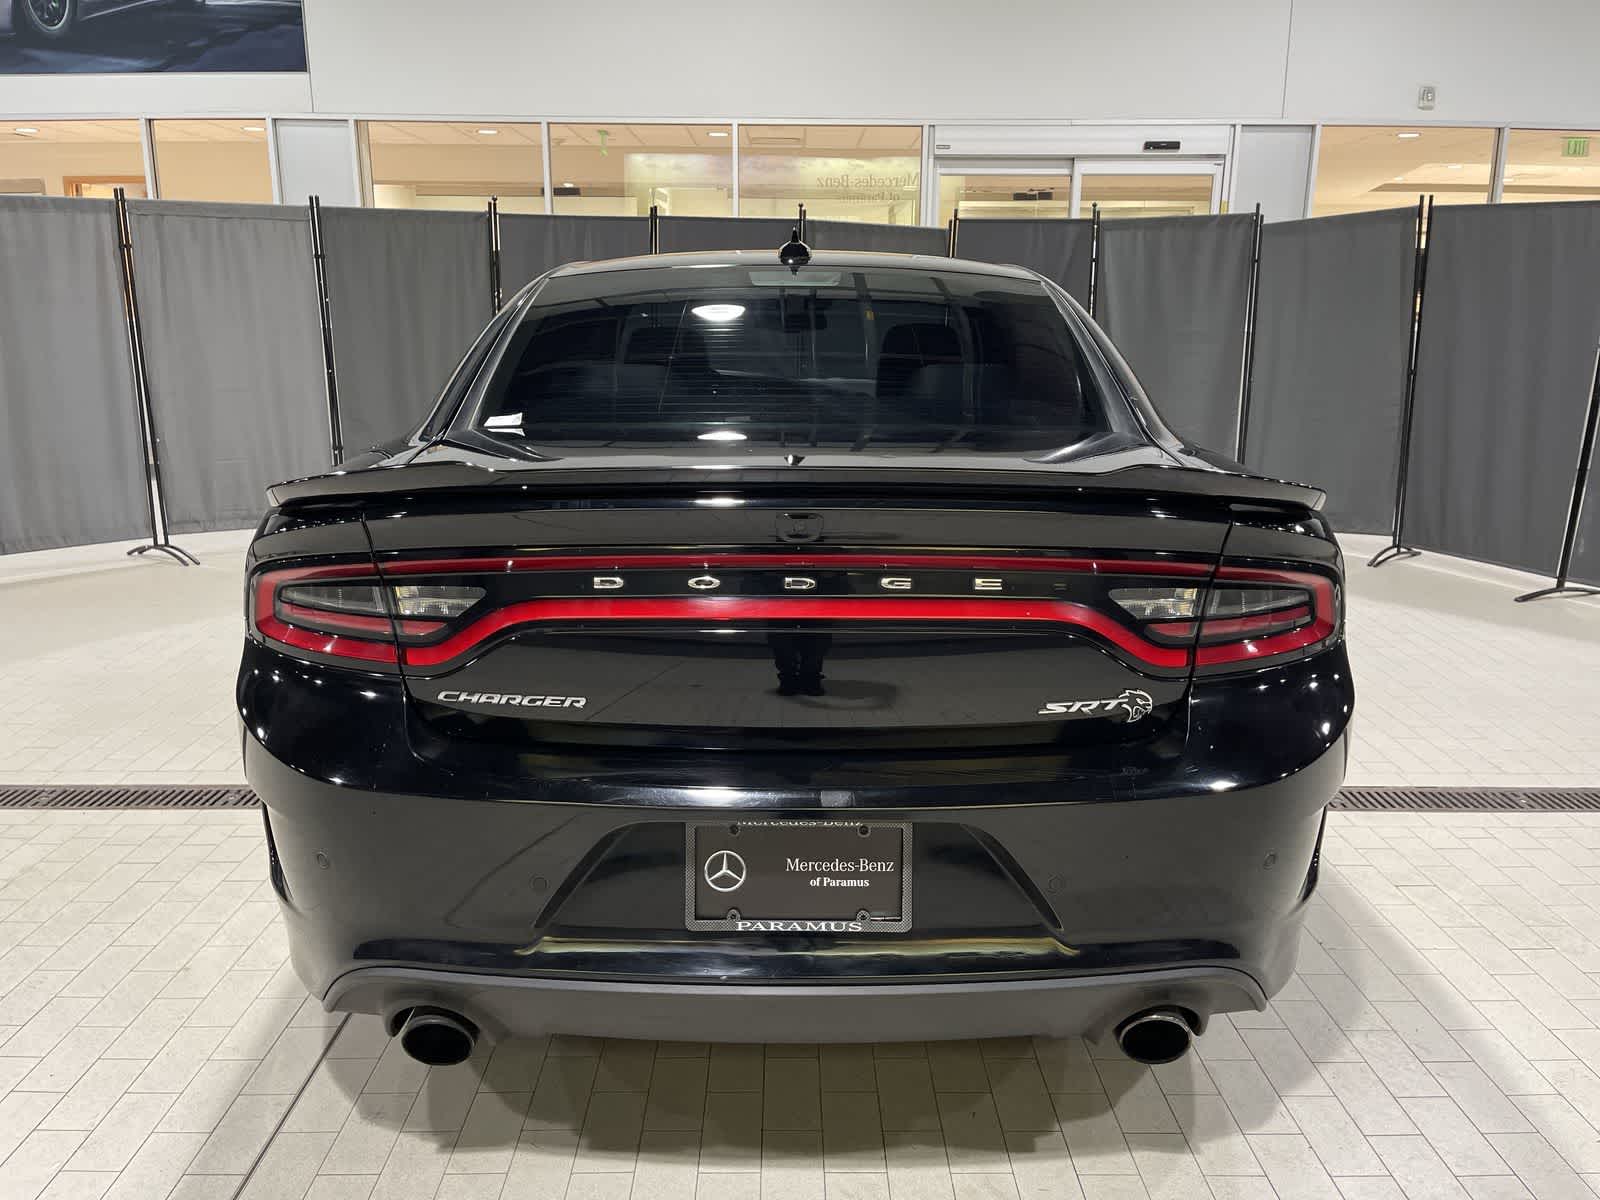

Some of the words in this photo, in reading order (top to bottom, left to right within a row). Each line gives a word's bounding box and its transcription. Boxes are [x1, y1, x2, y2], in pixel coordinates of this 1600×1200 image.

[593, 576, 1003, 590] DODGE
[437, 690, 587, 709] CHARGER
[1038, 698, 1128, 715] SRT
[785, 858, 894, 872] Mercedes-Benz
[809, 877, 820, 887] of
[823, 877, 870, 888] Paramus
[735, 921, 863, 932] PARAMUS
